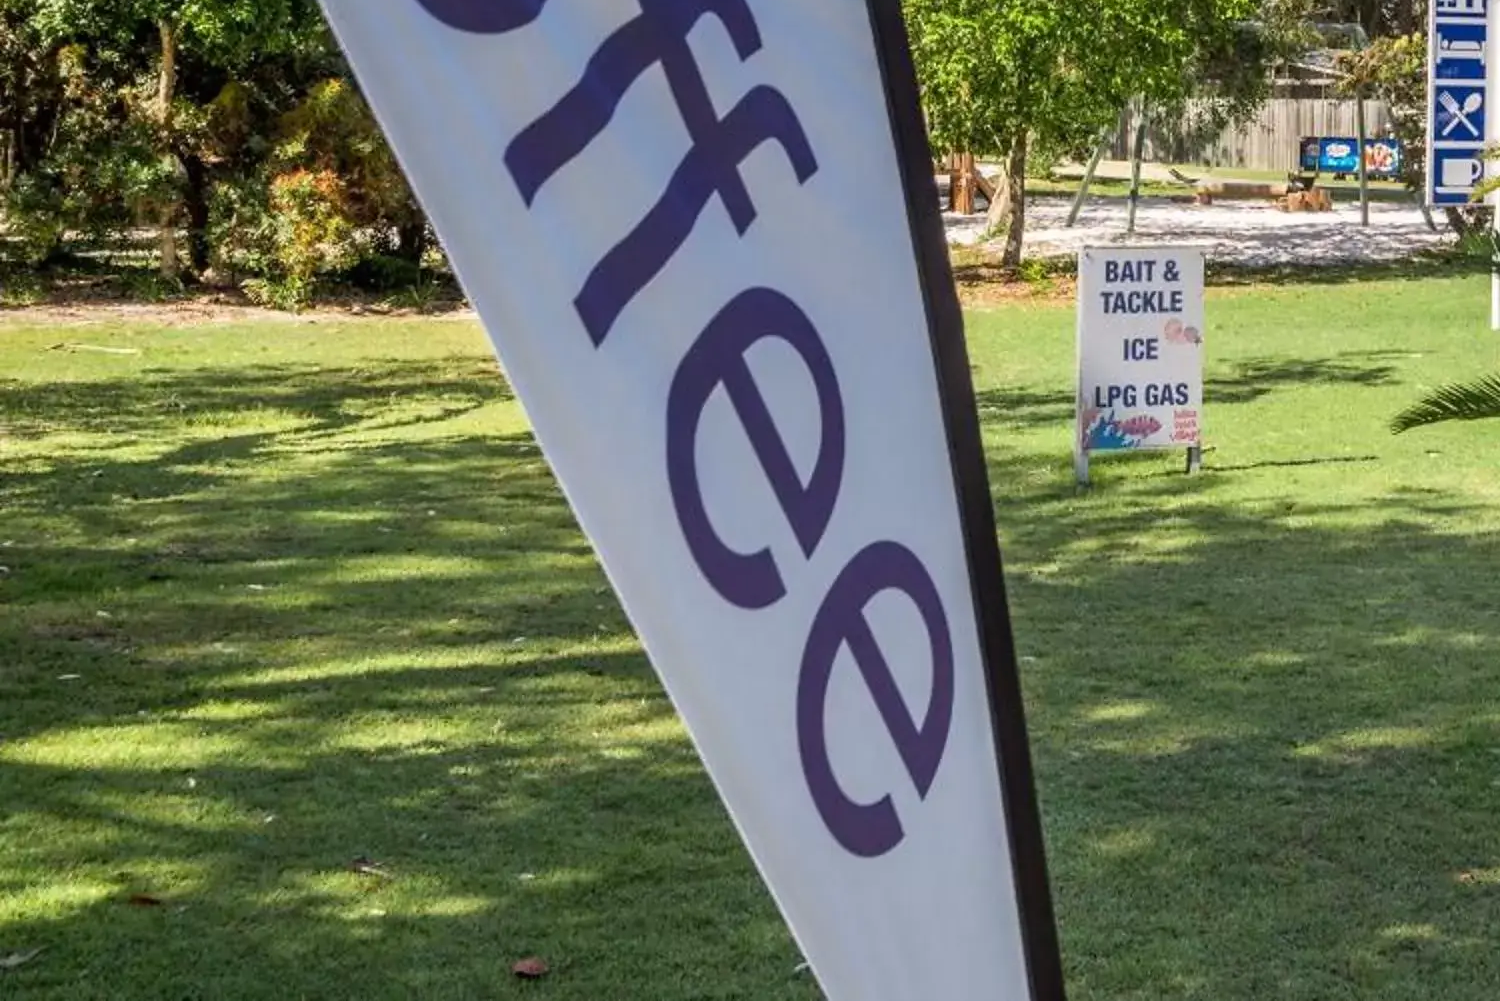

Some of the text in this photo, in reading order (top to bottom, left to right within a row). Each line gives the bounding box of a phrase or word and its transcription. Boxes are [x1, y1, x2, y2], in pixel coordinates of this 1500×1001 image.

[1105, 259, 1180, 284] BAIT &
[1101, 290, 1183, 314] TACKLE
[1123, 338, 1159, 361] ICE
[1095, 382, 1189, 409] LPG GAS
